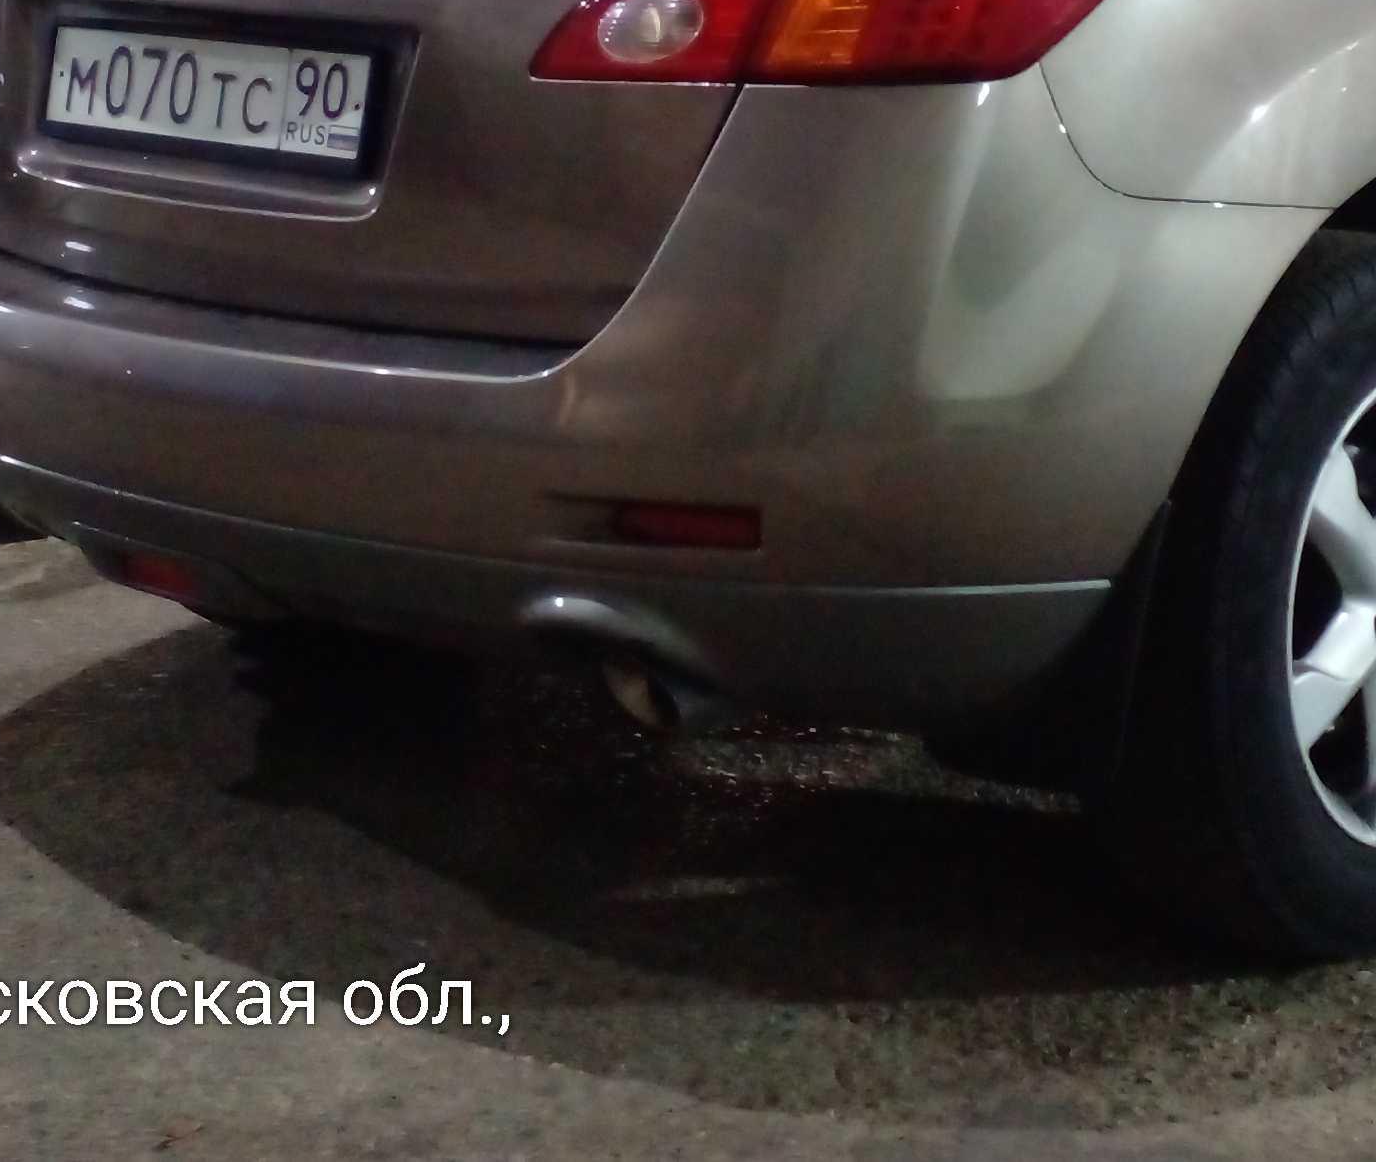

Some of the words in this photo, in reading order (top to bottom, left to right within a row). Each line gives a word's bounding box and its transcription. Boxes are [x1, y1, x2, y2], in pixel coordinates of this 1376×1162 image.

[65, 44, 273, 134] М070ТС
[295, 57, 349, 120] 90
[286, 120, 325, 147] RUS
